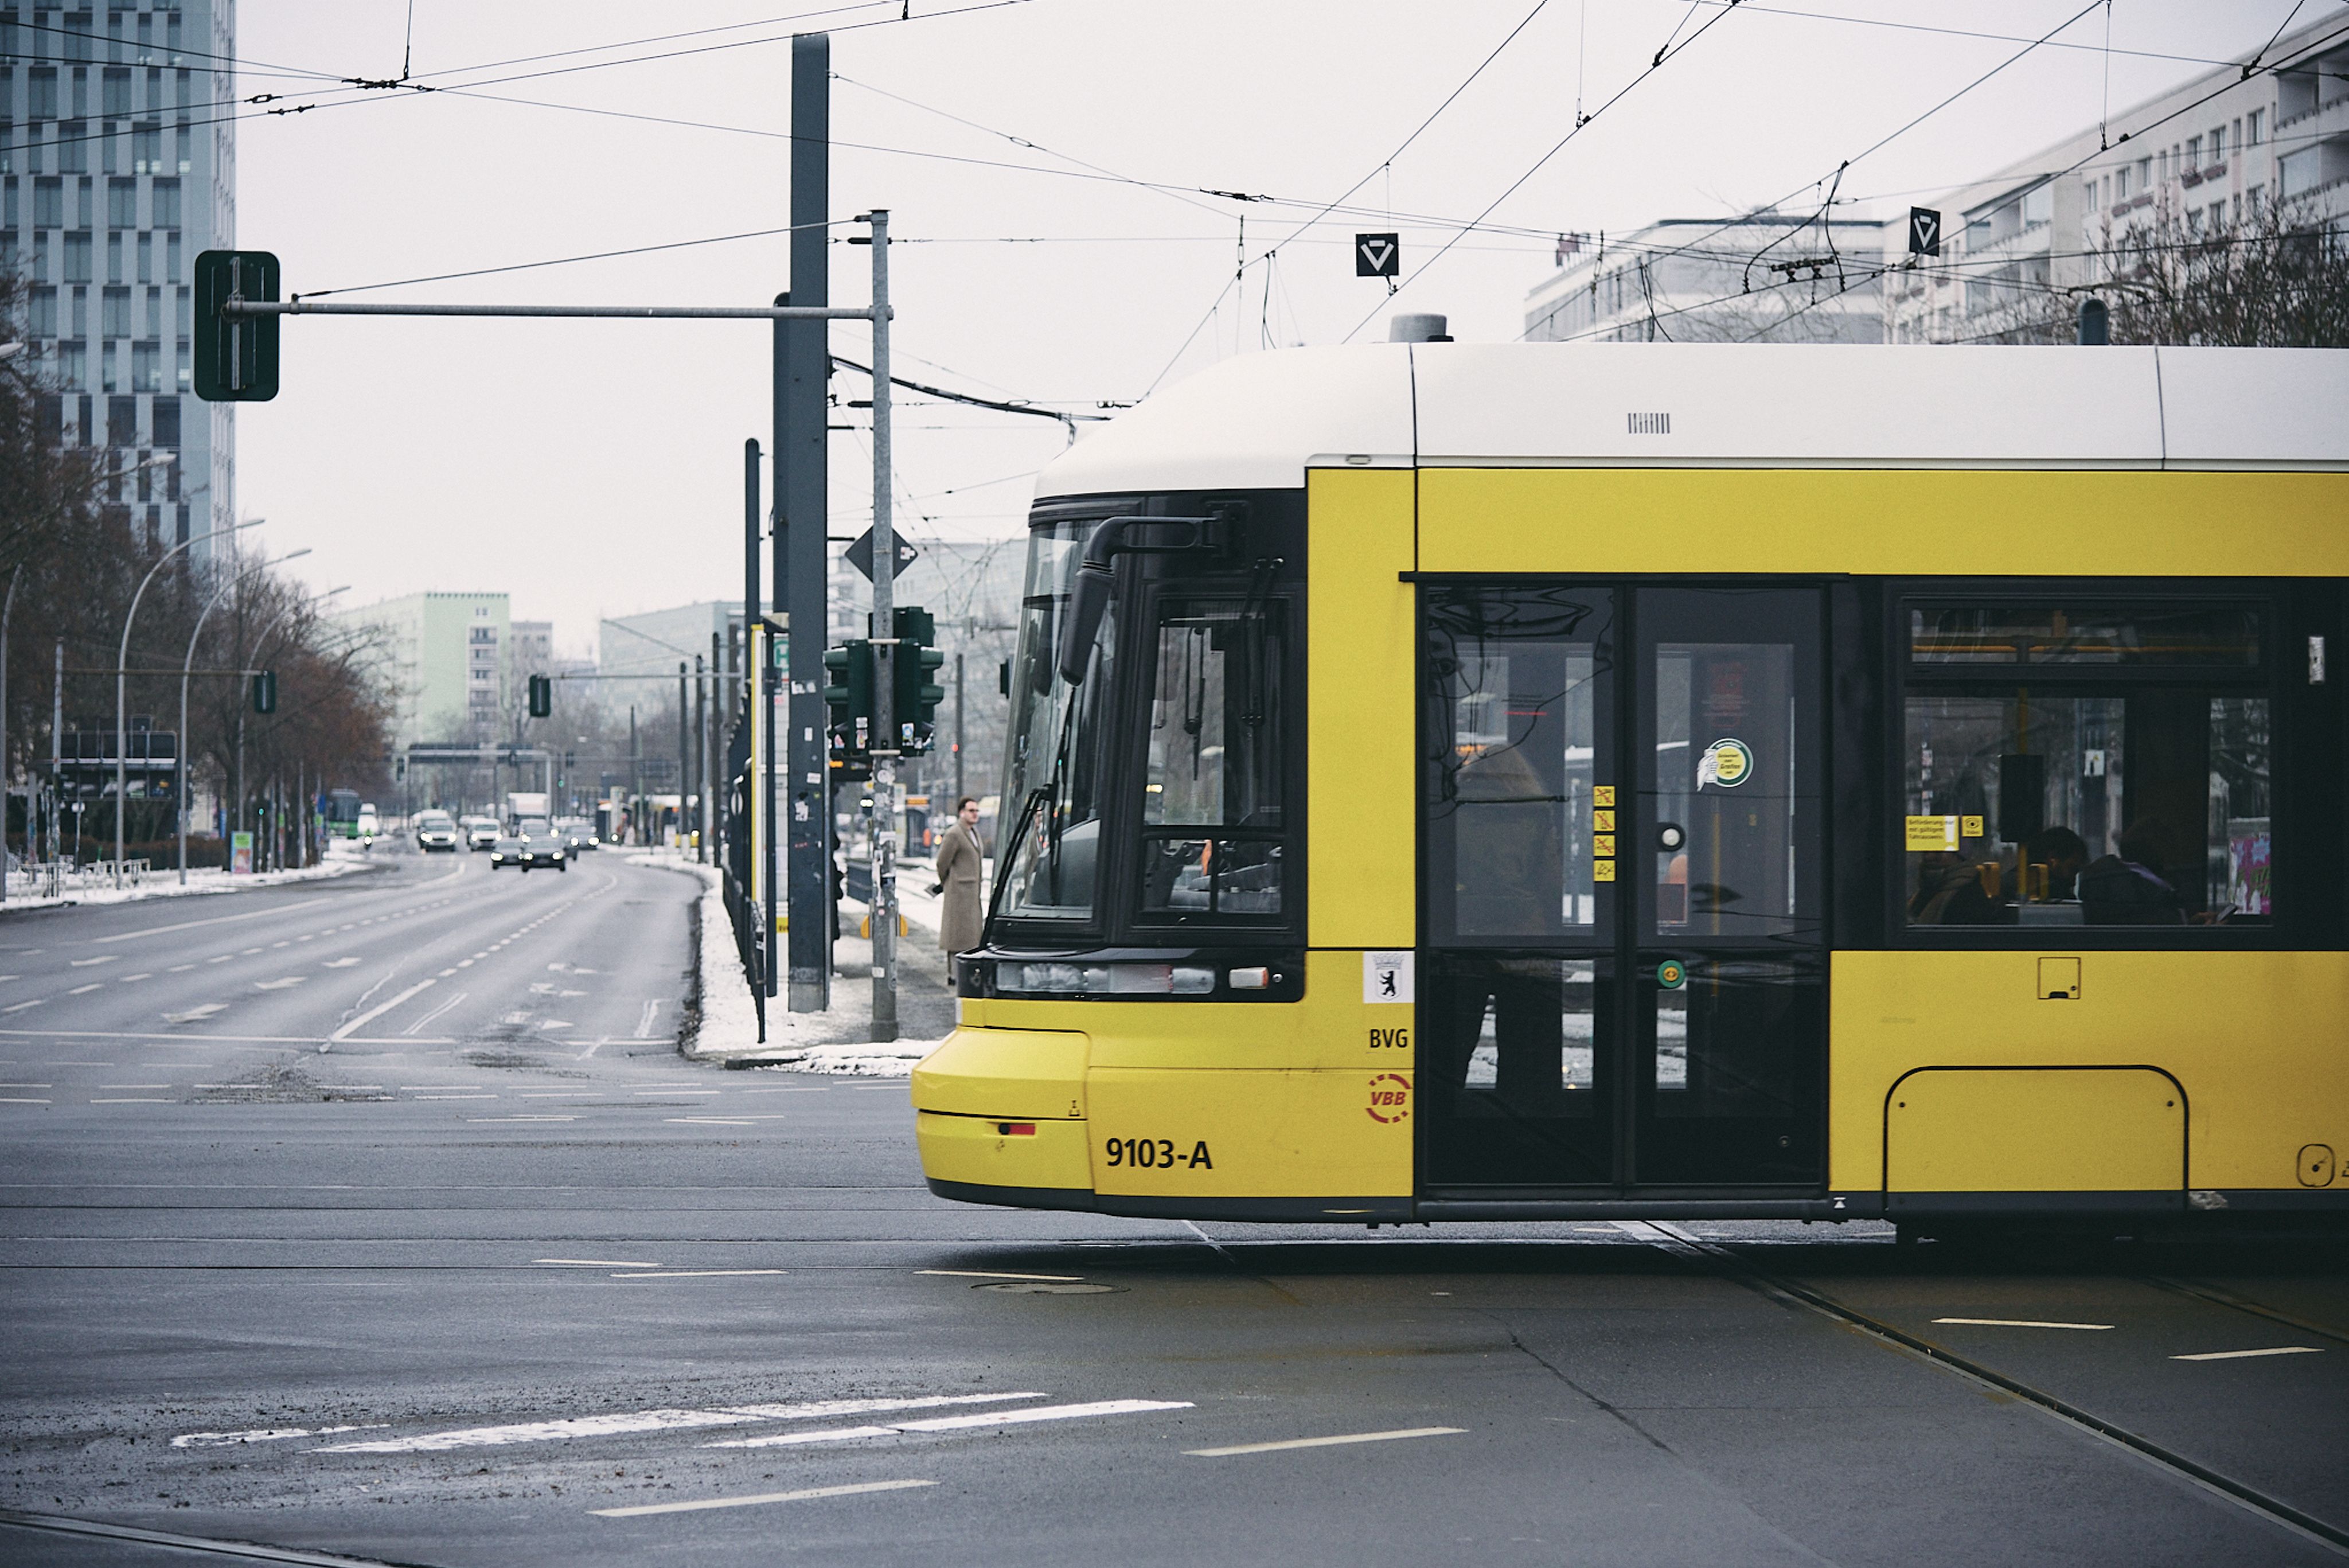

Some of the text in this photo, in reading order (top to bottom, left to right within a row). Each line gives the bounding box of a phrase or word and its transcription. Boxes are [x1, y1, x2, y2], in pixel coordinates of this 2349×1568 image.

[1370, 1028, 1407, 1048] BVG
[1371, 1091, 1406, 1106] VBB
[1106, 1138, 1213, 1169] 9103-A
